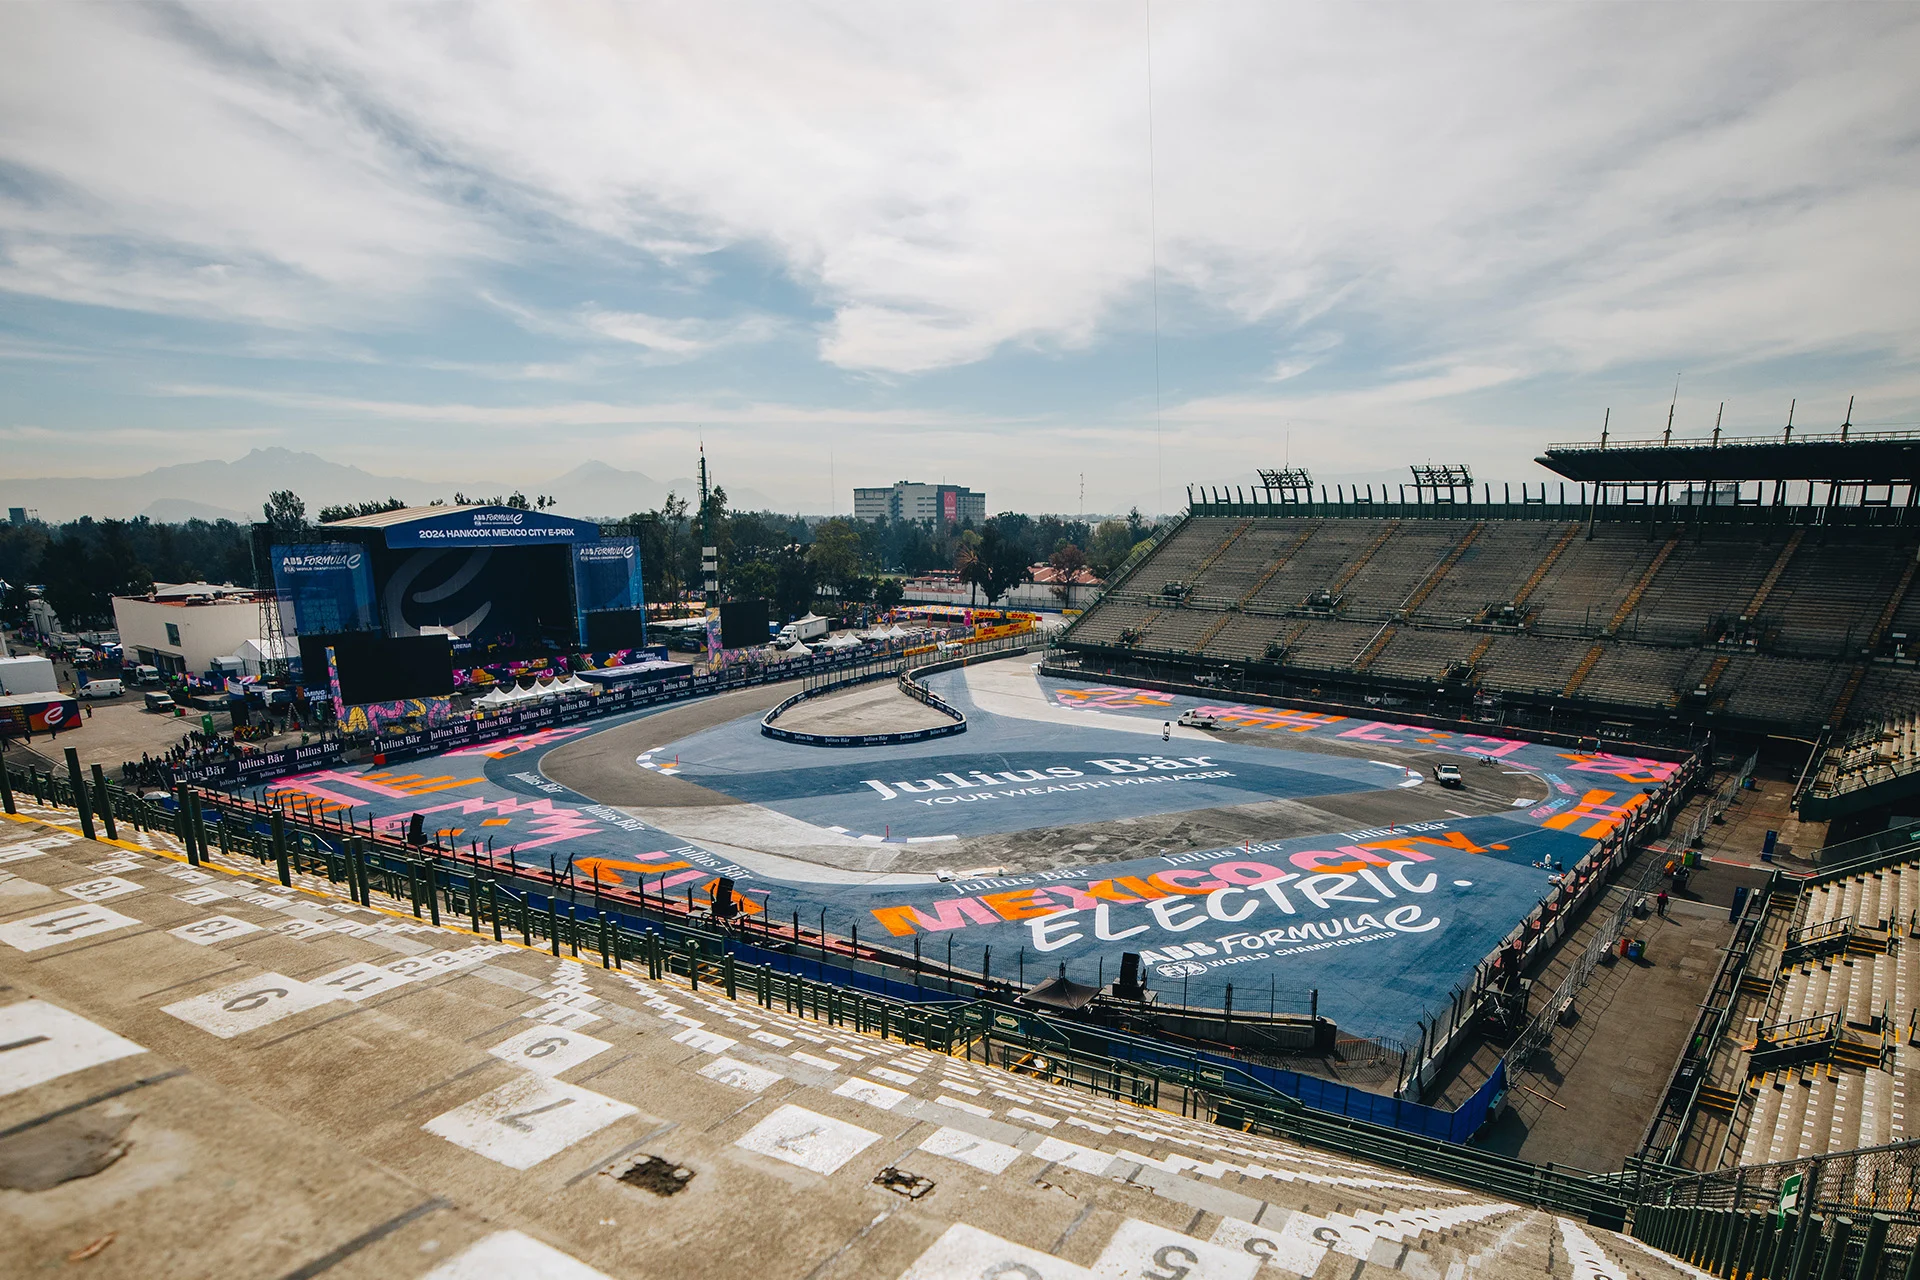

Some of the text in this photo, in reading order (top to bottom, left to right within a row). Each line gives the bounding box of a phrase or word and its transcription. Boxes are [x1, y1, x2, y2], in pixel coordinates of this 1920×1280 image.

[419, 528, 574, 538] 2024 HANKOOK MEXICO CITY E-PRIX
[594, 546, 624, 556] FORMULA
[283, 557, 302, 566] ABB
[302, 555, 347, 566] FORMULA
[632, 689, 647, 698] Julius
[663, 684, 678, 692] Julius
[560, 700, 590, 713] Julius Bär
[597, 692, 625, 705] Julius Bär
[476, 716, 512, 731] Julius Bär
[520, 708, 552, 721] Julius Bär
[430, 725, 468, 741] Julius Bär
[296, 743, 340, 760] Julius Bär
[380, 735, 421, 752] Julius Bär
[205, 765, 227, 777] Bär
[238, 753, 285, 772] Julius Bär
[297, 762, 313, 770] Julius
[220, 778, 237, 787] Julius
[260, 770, 276, 778] Julius
[860, 755, 1221, 801] Julius Bär
[914, 768, 1237, 806] YOUR WEALTH MANAGER
[578, 804, 646, 832] Julius Bär
[1340, 820, 1450, 842] Julius Bär
[668, 846, 753, 880] Julius Bär
[1161, 842, 1284, 867] Julius Bär
[72, 881, 121, 897] 15
[950, 868, 1090, 895] Julius Bär
[870, 861, 1287, 937] MEXICO
[30, 912, 106, 935] 11
[186, 920, 238, 938] 13
[274, 922, 314, 936] 15
[1140, 942, 1218, 966] ABB
[1216, 913, 1386, 954] FORMULA
[1206, 952, 1270, 968] WORLD
[1274, 931, 1396, 957] CHAMPIONSHIP
[388, 960, 432, 978] 13
[325, 970, 384, 992] 11
[222, 987, 289, 1013] 9
[523, 1036, 570, 1059] 9
[496, 1098, 576, 1133] 7
[1142, 1246, 1198, 1280] 5
